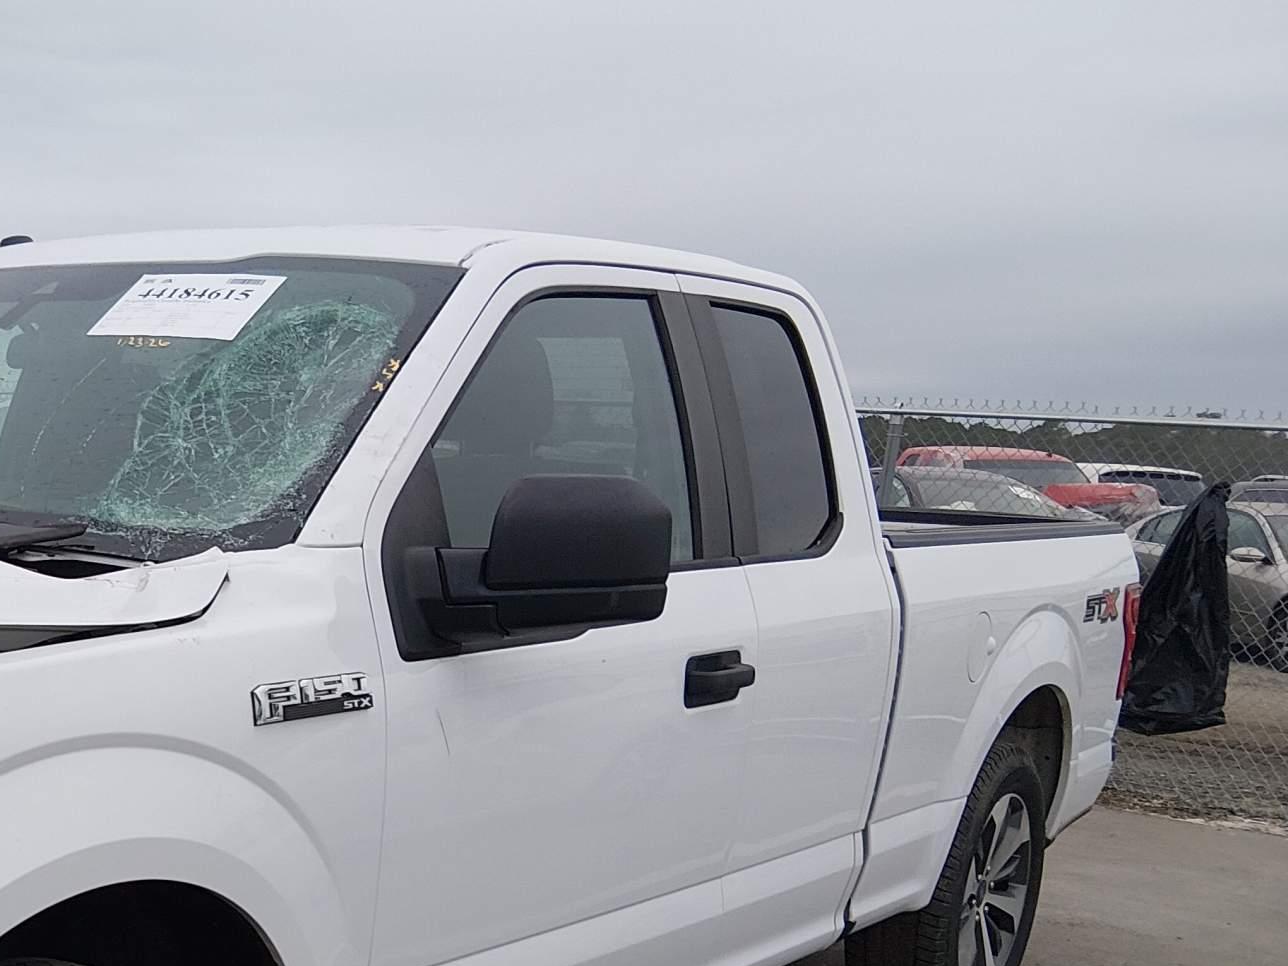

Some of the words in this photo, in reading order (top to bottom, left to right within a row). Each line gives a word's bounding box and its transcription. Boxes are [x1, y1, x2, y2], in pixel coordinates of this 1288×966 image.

[138, 288, 255, 302] 44184615
[1083, 587, 1120, 624] STX
[343, 697, 372, 710] STX
